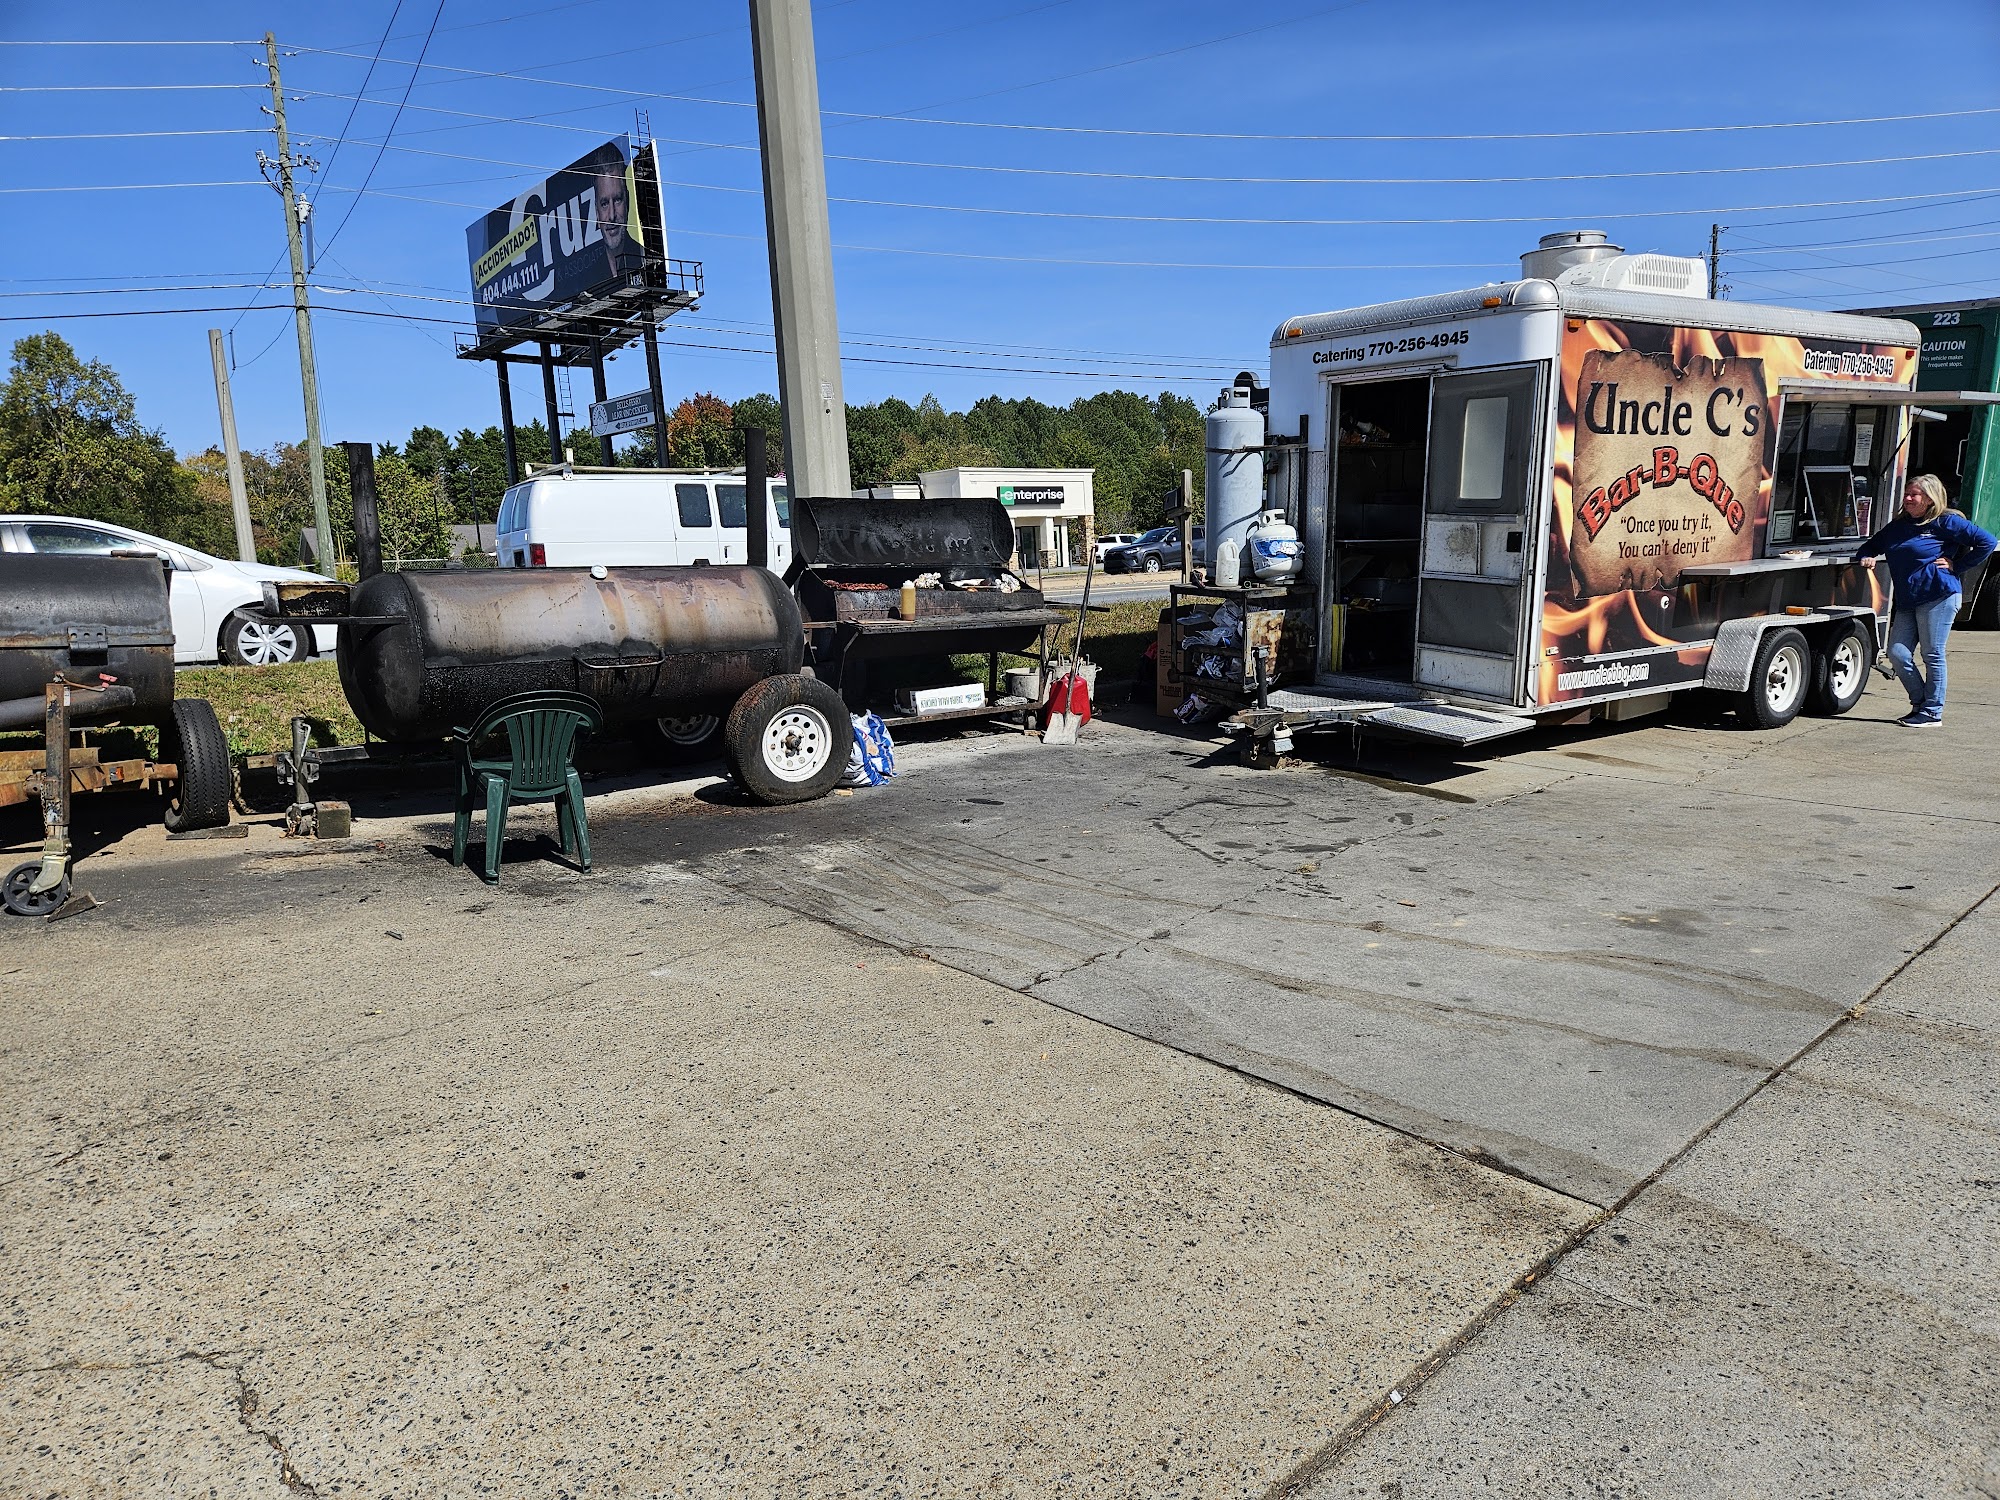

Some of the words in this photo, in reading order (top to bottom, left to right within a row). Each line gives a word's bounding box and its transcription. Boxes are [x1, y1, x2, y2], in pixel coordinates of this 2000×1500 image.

[475, 221, 535, 287] ¿ACCIDENTADO?
[508, 179, 604, 301] Cruz
[482, 262, 540, 304] 404.444.1111
[1932, 312, 1961, 326] 223
[1312, 347, 1365, 364] Catering
[1369, 330, 1469, 357] 770-256-4945
[1921, 340, 1967, 352] CAUTION
[1804, 350, 1841, 375] Catering
[1842, 353, 1894, 376] 770-256-4945
[1584, 380, 1693, 436] Uncle
[1705, 386, 1761, 437] C's
[1001, 488, 1064, 503] enterprise
[1577, 445, 1746, 543] Bar-B-Que
[1658, 519, 1679, 536] you
[1682, 515, 1699, 534] try
[1700, 513, 1712, 531] it,
[1618, 541, 1640, 559] You
[1642, 538, 1670, 557] can't
[1672, 537, 1699, 558] deny
[1558, 662, 1650, 692] www.unclecbbq.com
